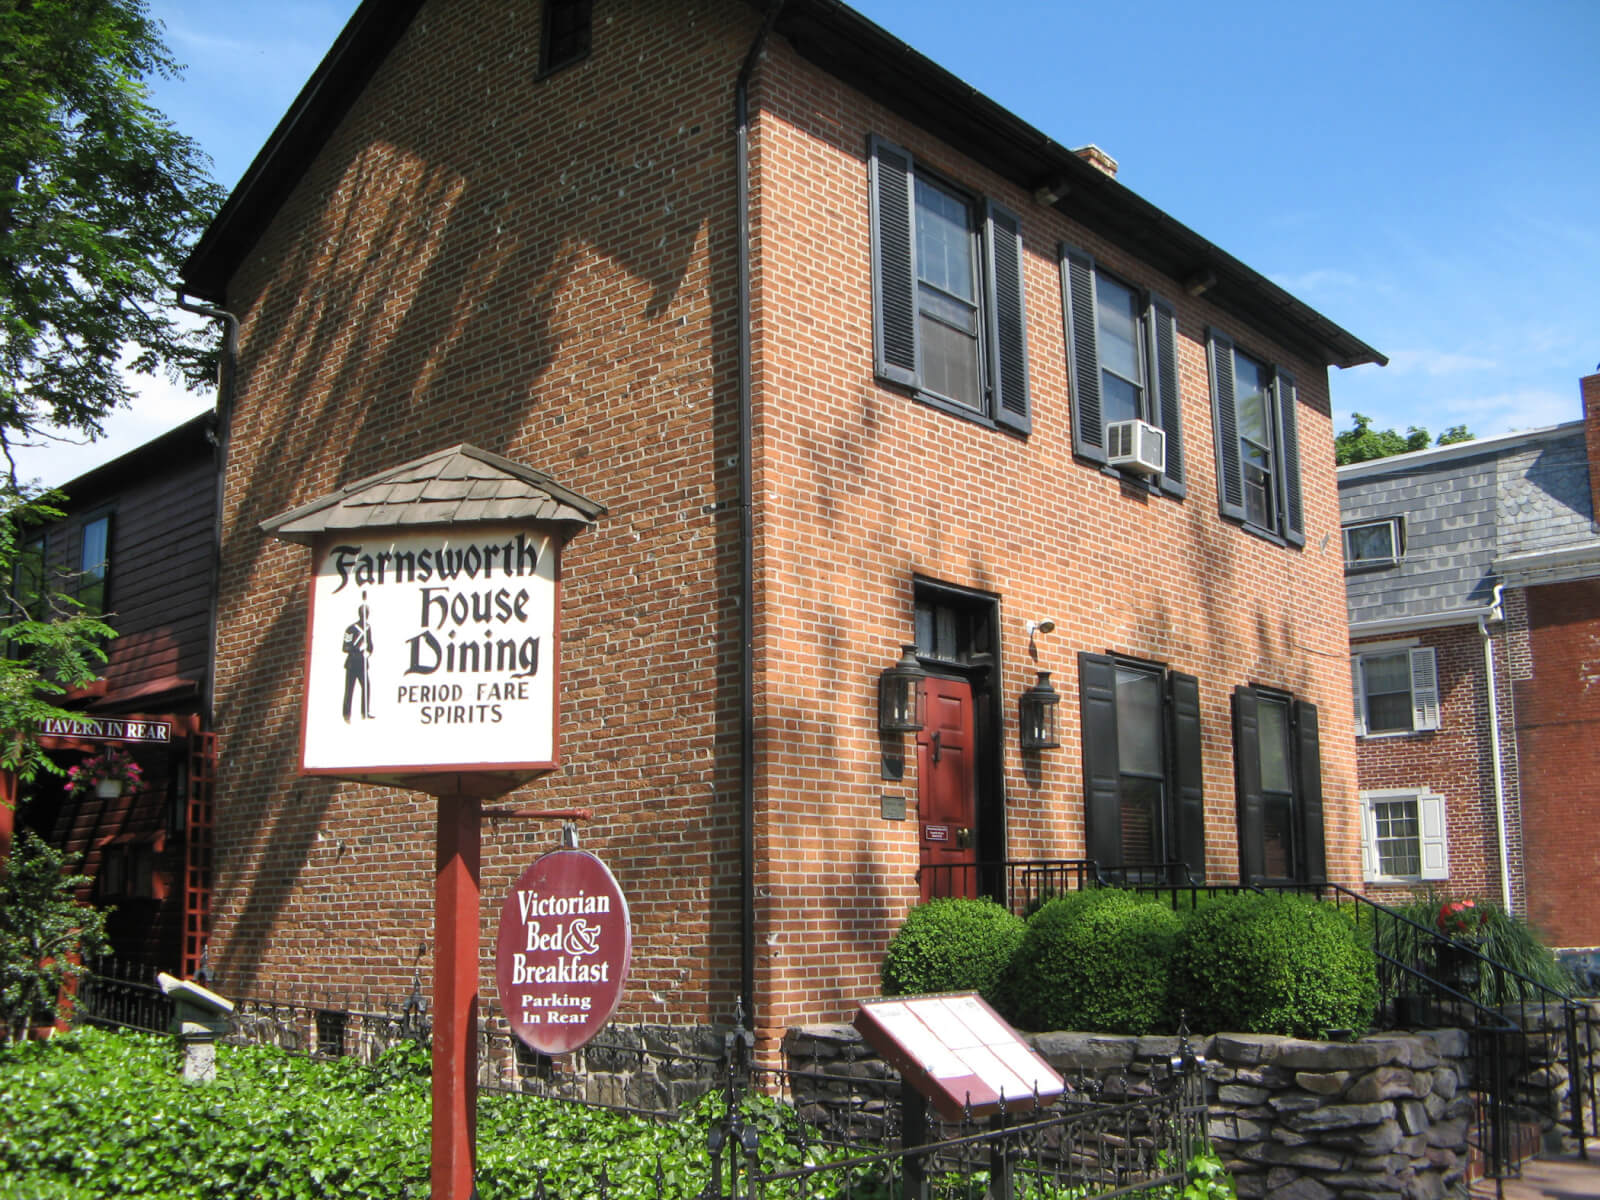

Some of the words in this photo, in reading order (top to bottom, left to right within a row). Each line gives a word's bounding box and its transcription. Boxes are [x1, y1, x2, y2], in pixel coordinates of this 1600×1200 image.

[330, 532, 537, 594] Farnsworth
[419, 586, 530, 630] House
[403, 629, 540, 679] Dining
[397, 684, 463, 703] PERIOD
[476, 682, 529, 701] FARE
[44, 718, 103, 735] TAVERN
[107, 722, 123, 736] IN
[126, 723, 167, 740] REAR
[420, 704, 503, 724] SPIRITS
[517, 890, 610, 925] Victorian
[526, 921, 563, 951] Bed
[563, 918, 601, 955] &
[511, 953, 609, 985] Breakfast
[521, 993, 592, 1010] Parking
[522, 1011, 541, 1024] In
[547, 1011, 589, 1024] Rear
